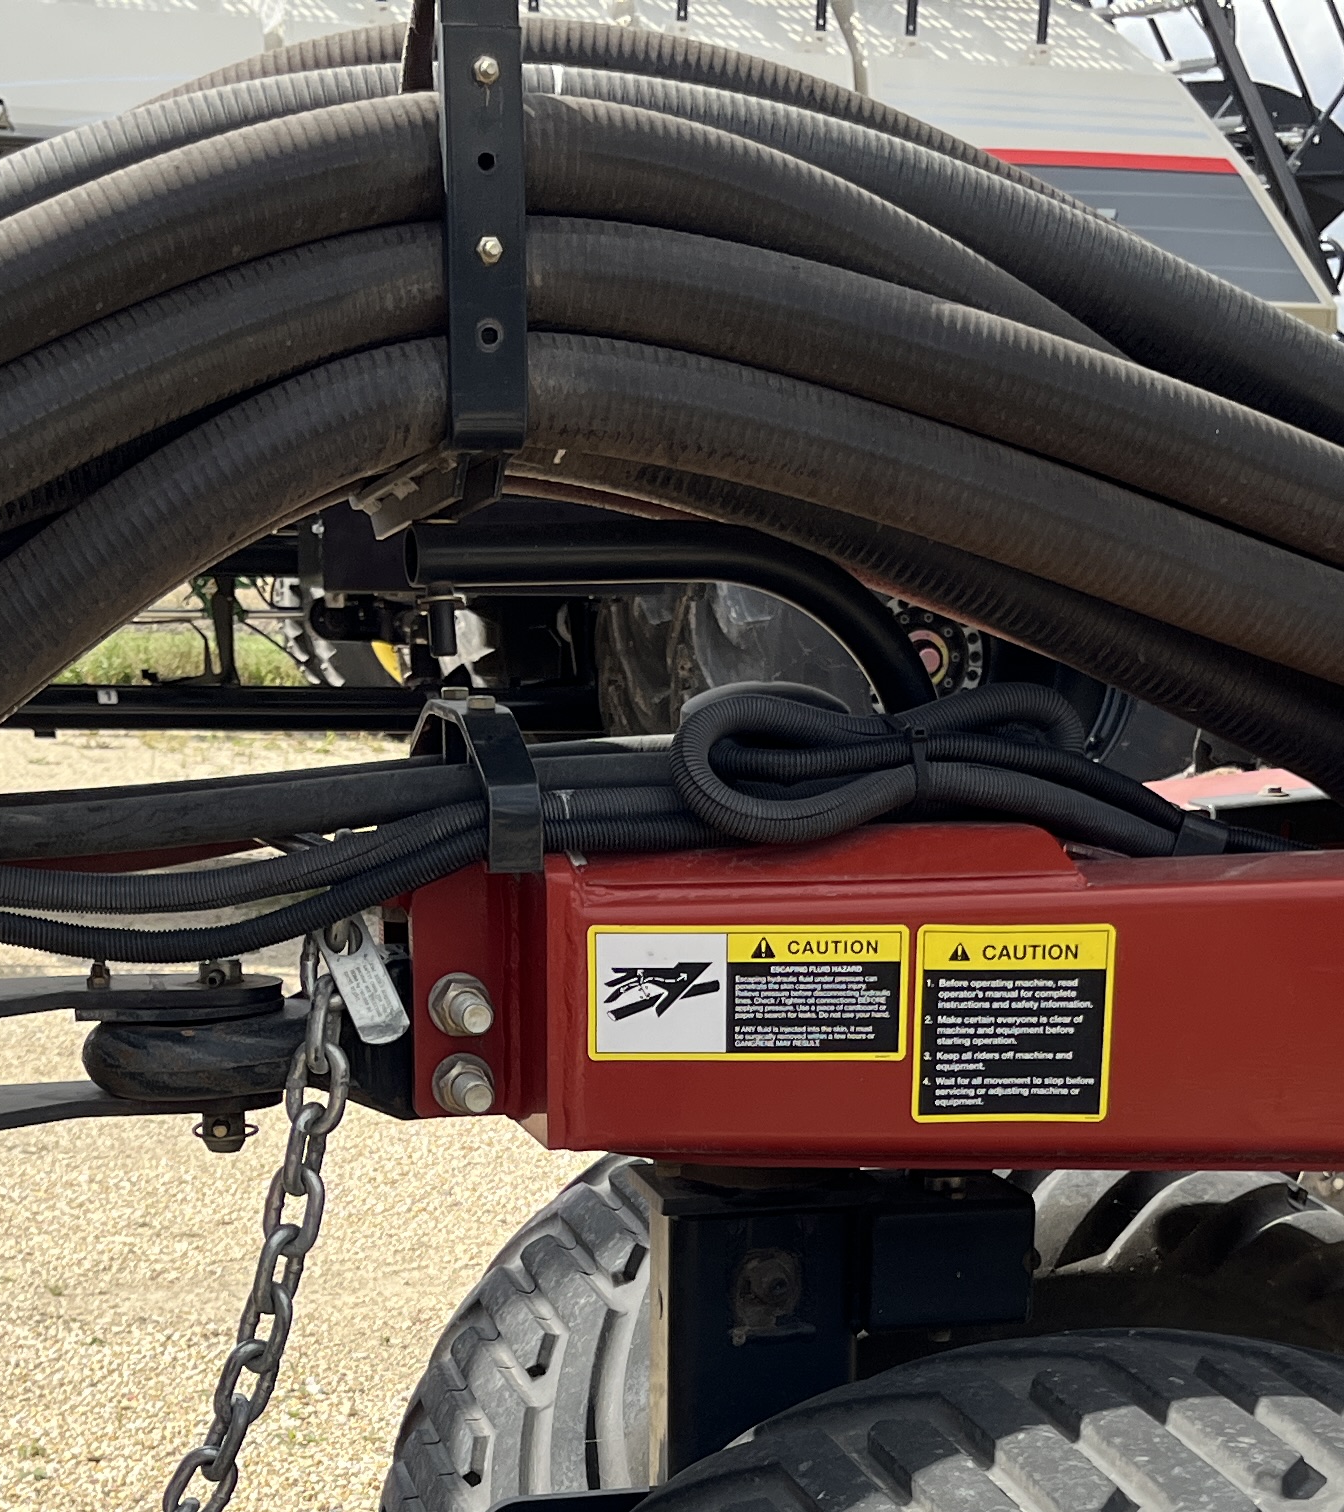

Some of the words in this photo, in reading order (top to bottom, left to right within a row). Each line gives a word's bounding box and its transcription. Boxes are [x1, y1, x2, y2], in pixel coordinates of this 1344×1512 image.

[787, 940, 879, 955] CAUTION
[982, 944, 1079, 960] CAUTION
[927, 979, 934, 987] 1.
[939, 979, 969, 987] Before
[970, 979, 1013, 989] operating
[1015, 979, 1056, 988] machine,
[1058, 978, 1078, 987] read
[985, 990, 1018, 998] manual
[1020, 989, 1033, 997] for
[1035, 989, 1077, 999] complete
[938, 1000, 990, 1008] instructions
[992, 1000, 1009, 1008] and
[1011, 1000, 1038, 1010] safety
[925, 1015, 933, 1024] 2.
[996, 1017, 1038, 1025] everyone
[1049, 1015, 1071, 1023] clear
[1073, 1015, 1083, 1023] of
[937, 1026, 975, 1034] machine
[976, 1026, 994, 1034] and
[996, 1026, 1043, 1035] equipment
[1045, 1026, 1074, 1034] before
[937, 1037, 970, 1046] starting
[924, 1052, 931, 1060] 3.
[937, 1052, 960, 1060] Keep
[961, 1051, 972, 1060] all
[1001, 1051, 1014, 1059] off
[1015, 1051, 1053, 1059] machine
[1055, 1051, 1073, 1059] and
[923, 1077, 931, 1085] 4.
[936, 1077, 955, 1085] Wait
[1044, 1077, 1064, 1085] stop
[1066, 1077, 1094, 1085] before
[935, 1087, 975, 1096] servicing
[988, 1087, 1029, 1096] adjusting
